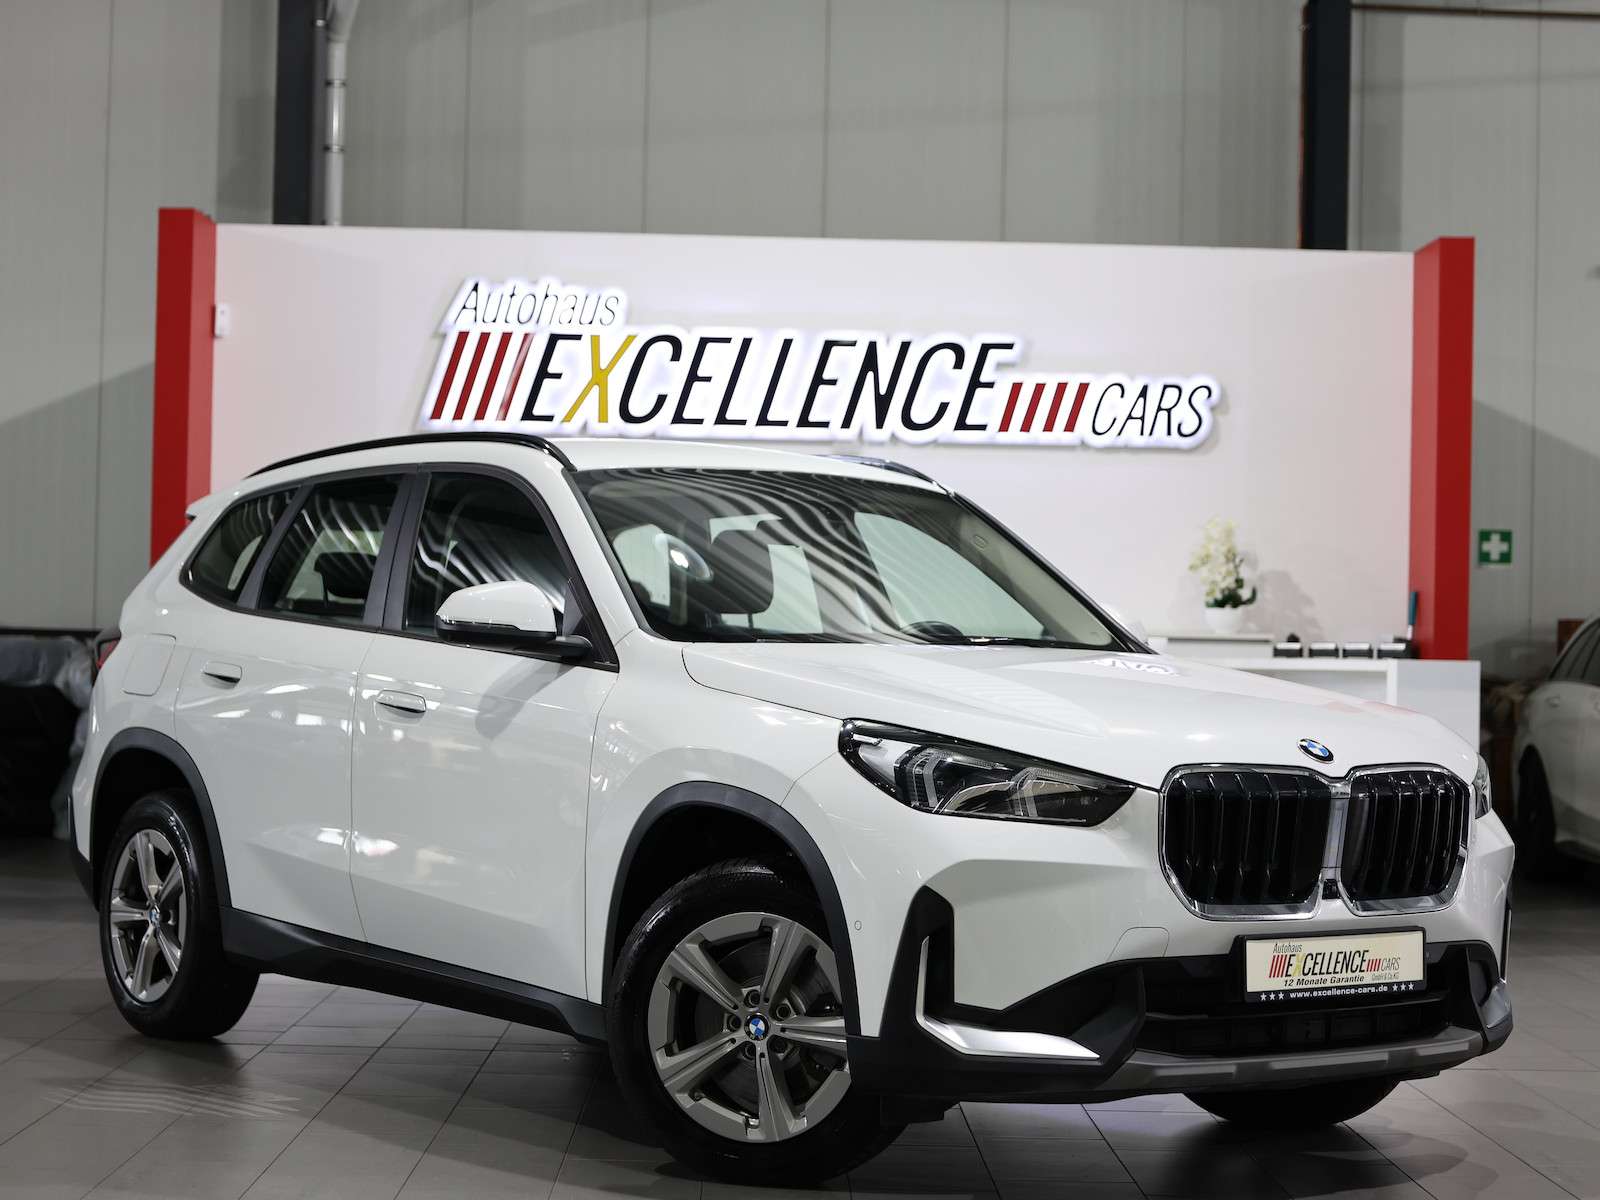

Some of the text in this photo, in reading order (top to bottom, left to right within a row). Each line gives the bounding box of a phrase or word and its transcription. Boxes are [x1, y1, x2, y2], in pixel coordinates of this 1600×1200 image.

[454, 281, 620, 327] Autohaus
[520, 333, 1212, 438] EXCELLENCE CARS
[1273, 942, 1303, 954] Autohaus
[1285, 949, 1401, 977] EXCELLENCE CARS
[1284, 975, 1365, 987] 12 Monate Garantie
[1289, 984, 1388, 999] www.excellence-cars.de
